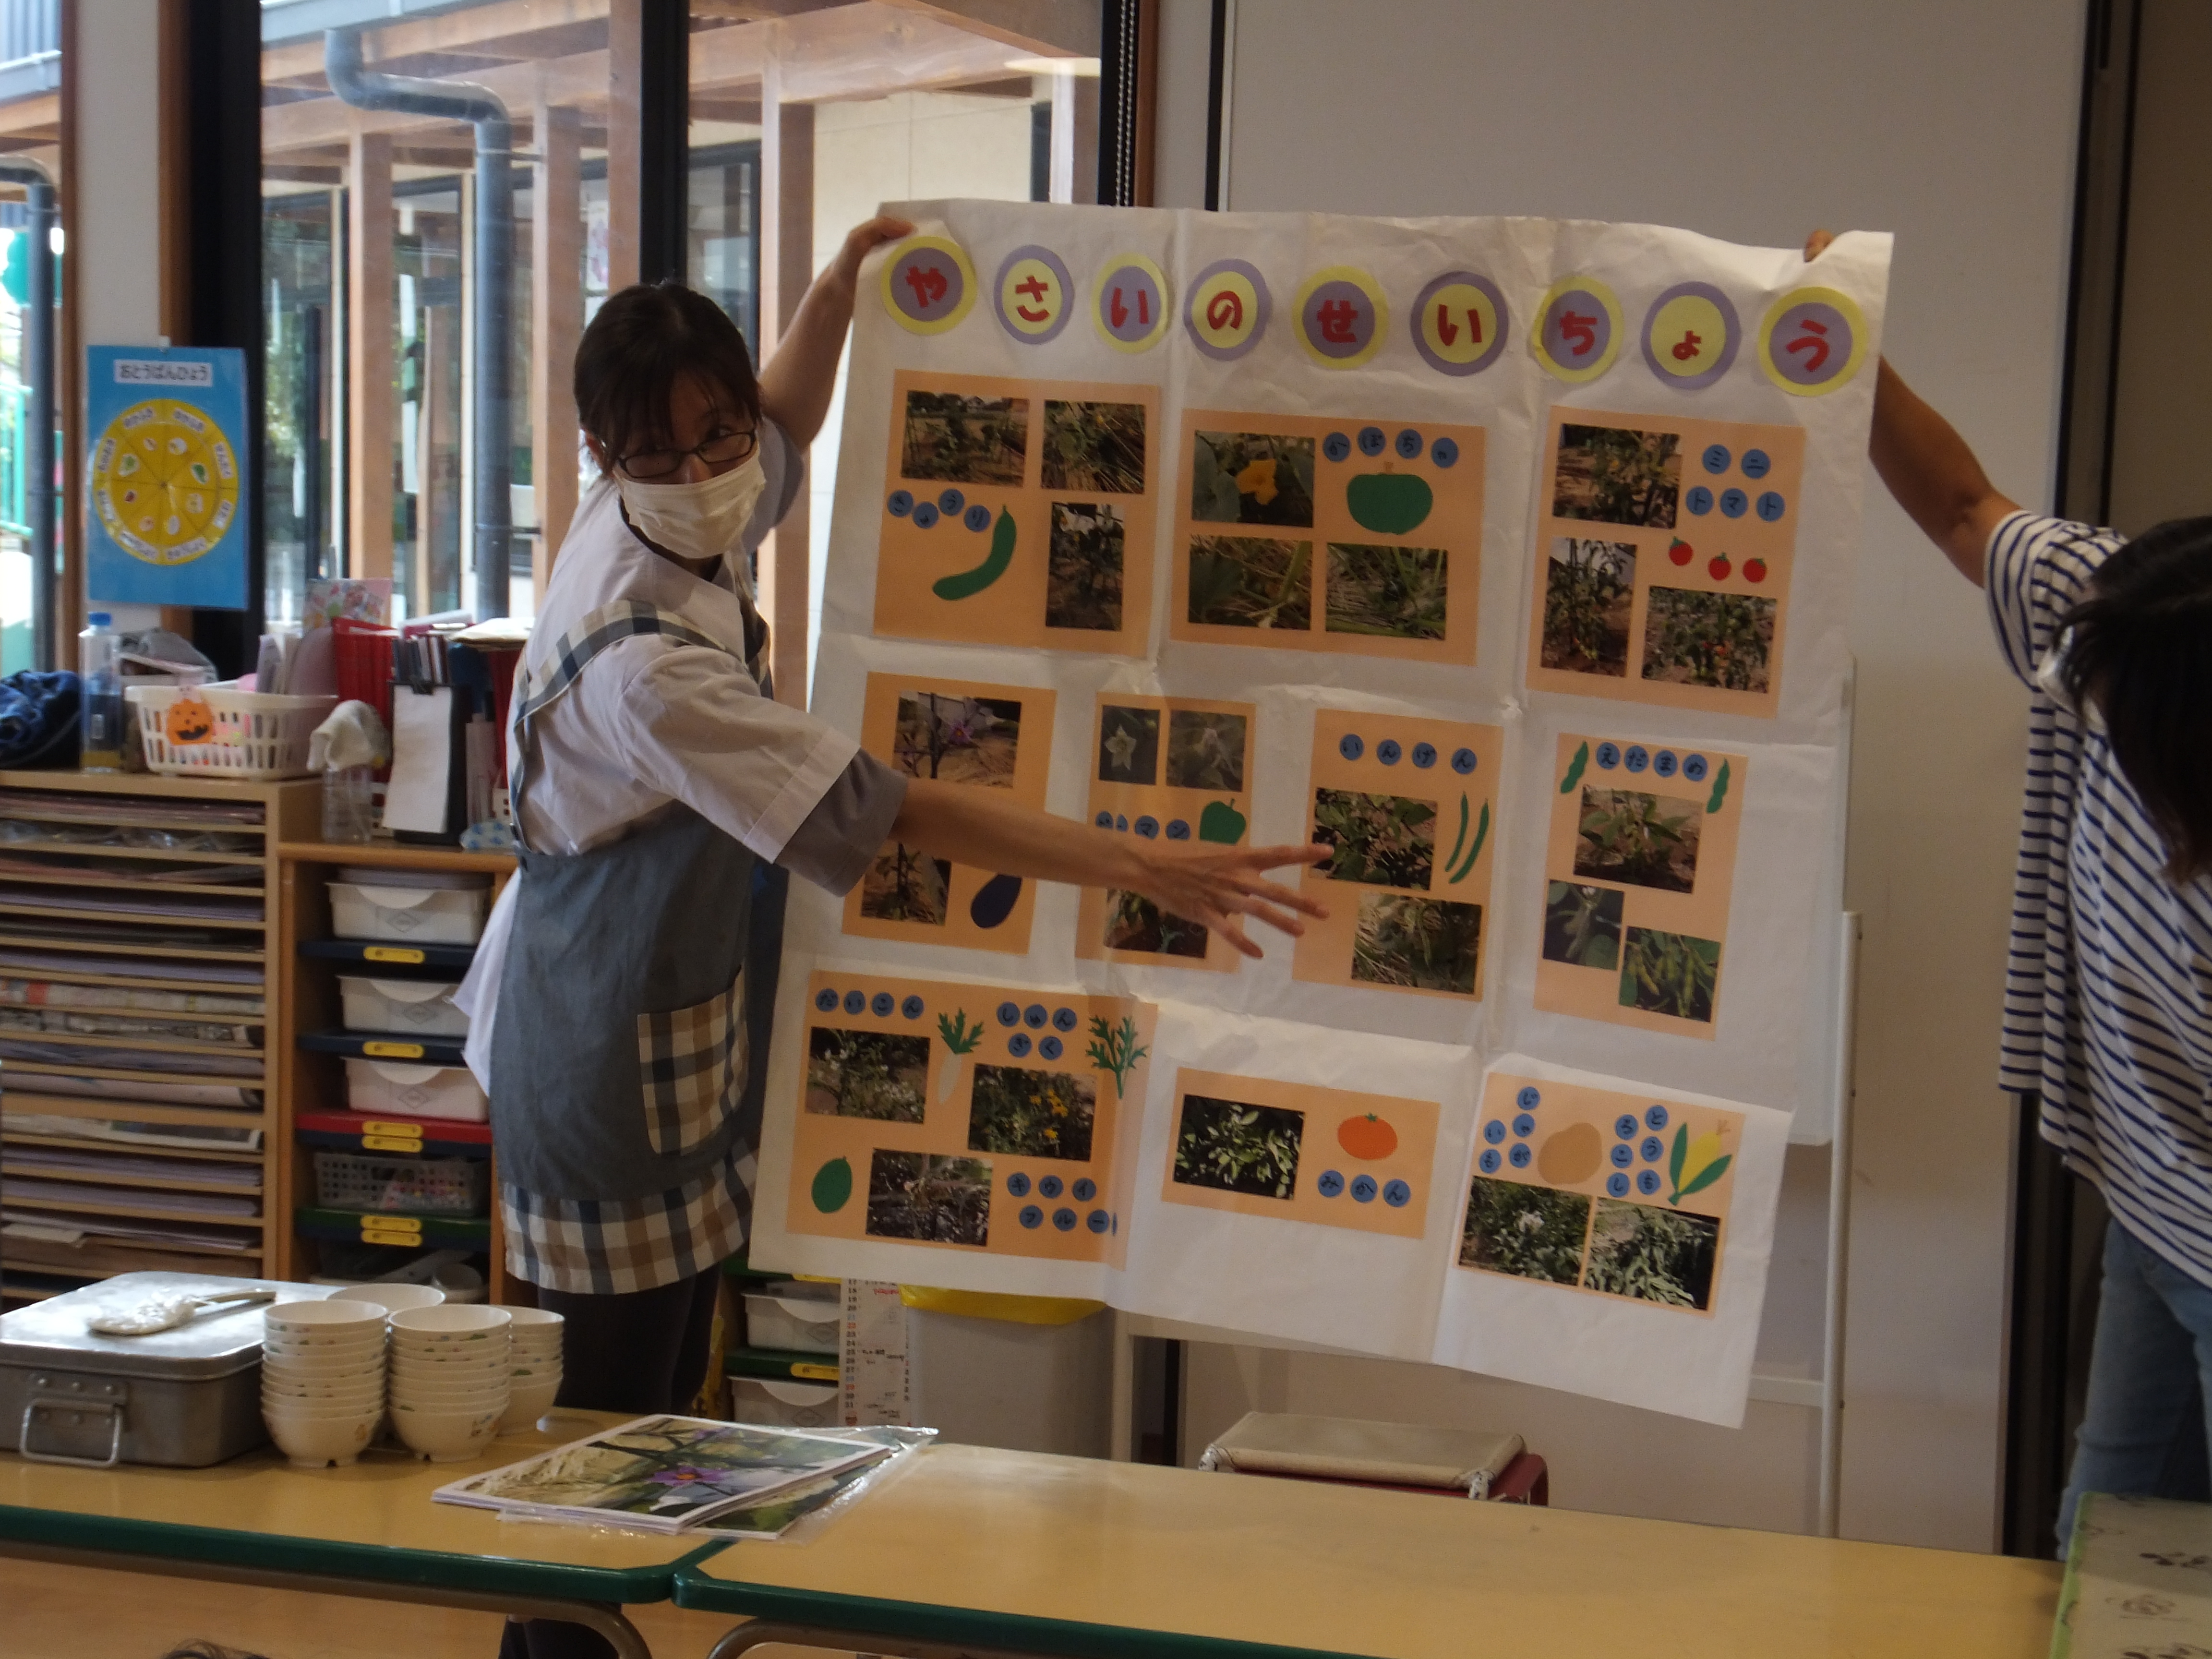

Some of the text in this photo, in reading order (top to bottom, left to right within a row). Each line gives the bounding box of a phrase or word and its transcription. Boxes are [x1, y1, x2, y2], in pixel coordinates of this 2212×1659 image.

[905, 265, 1831, 373] やさいのせいちょう
[1328, 433, 1447, 460] かぼちゃ
[1342, 741, 1473, 769] いんげん
[1600, 746, 1704, 776] えだまめ
[818, 992, 920, 1014] だいこん
[1319, 1174, 1404, 1202] みかん
